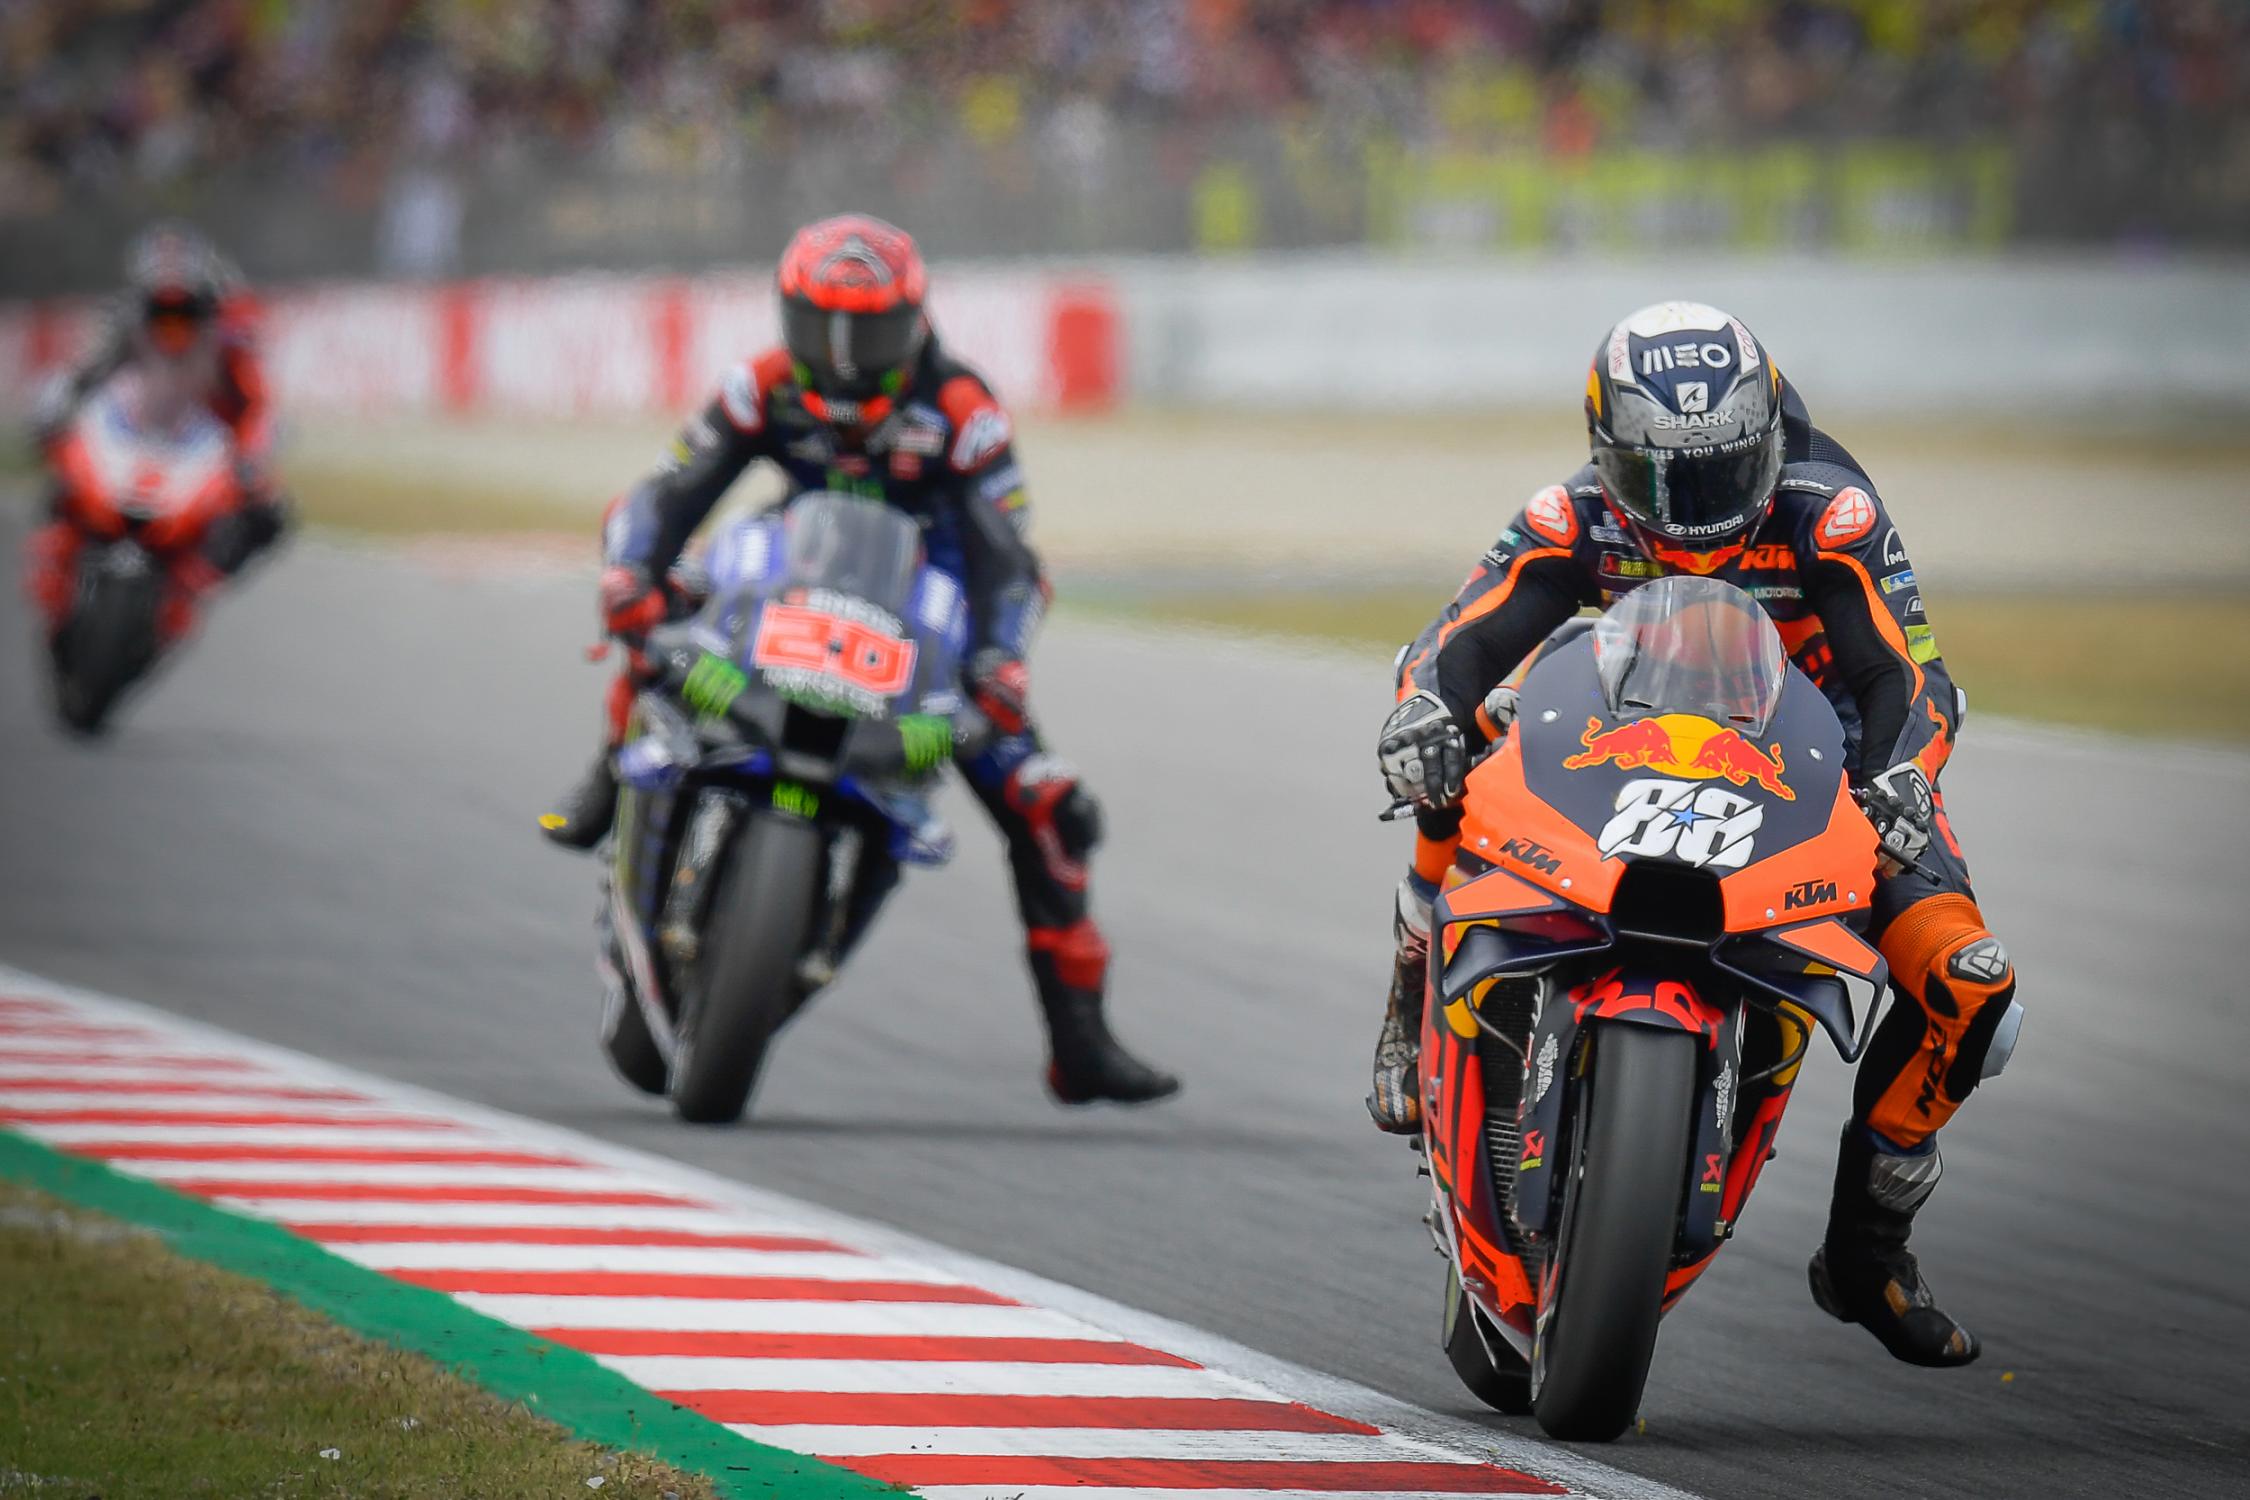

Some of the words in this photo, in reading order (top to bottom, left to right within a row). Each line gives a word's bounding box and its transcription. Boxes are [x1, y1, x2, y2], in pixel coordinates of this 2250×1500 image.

[1643, 342, 1731, 375] MEO
[1653, 408, 1736, 430] SHARK
[1634, 446, 1675, 460] GIVES
[1683, 445, 1714, 459] YOU
[1720, 432, 1762, 453] WINGS
[1688, 514, 1744, 536] HYUNDAI
[1738, 544, 1796, 571] KTM
[755, 604, 917, 694] 20
[1597, 778, 1764, 869] 88
[1499, 837, 1564, 875] KTM
[1784, 879, 1837, 911] KTM
